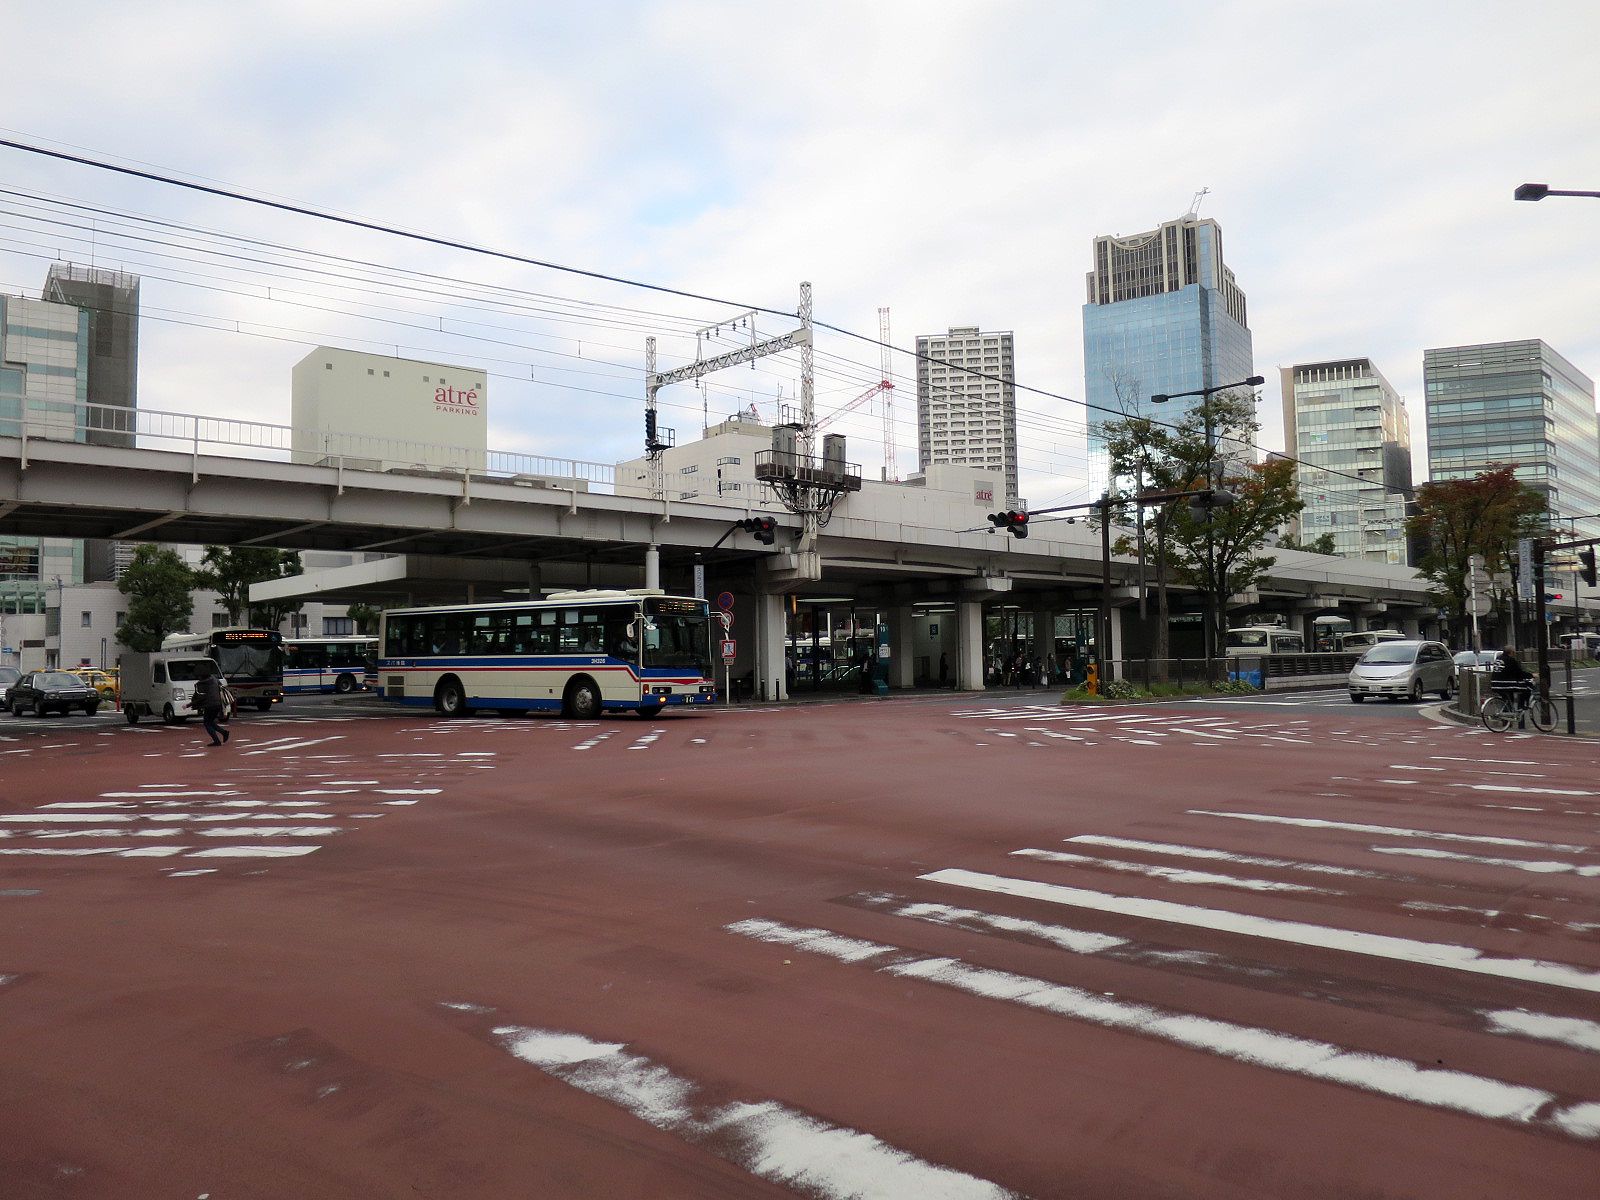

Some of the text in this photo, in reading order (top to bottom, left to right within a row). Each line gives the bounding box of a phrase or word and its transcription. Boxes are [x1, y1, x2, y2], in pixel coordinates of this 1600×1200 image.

[435, 385, 477, 406] atré
[436, 405, 477, 416] PARKING
[976, 489, 992, 501] atré
